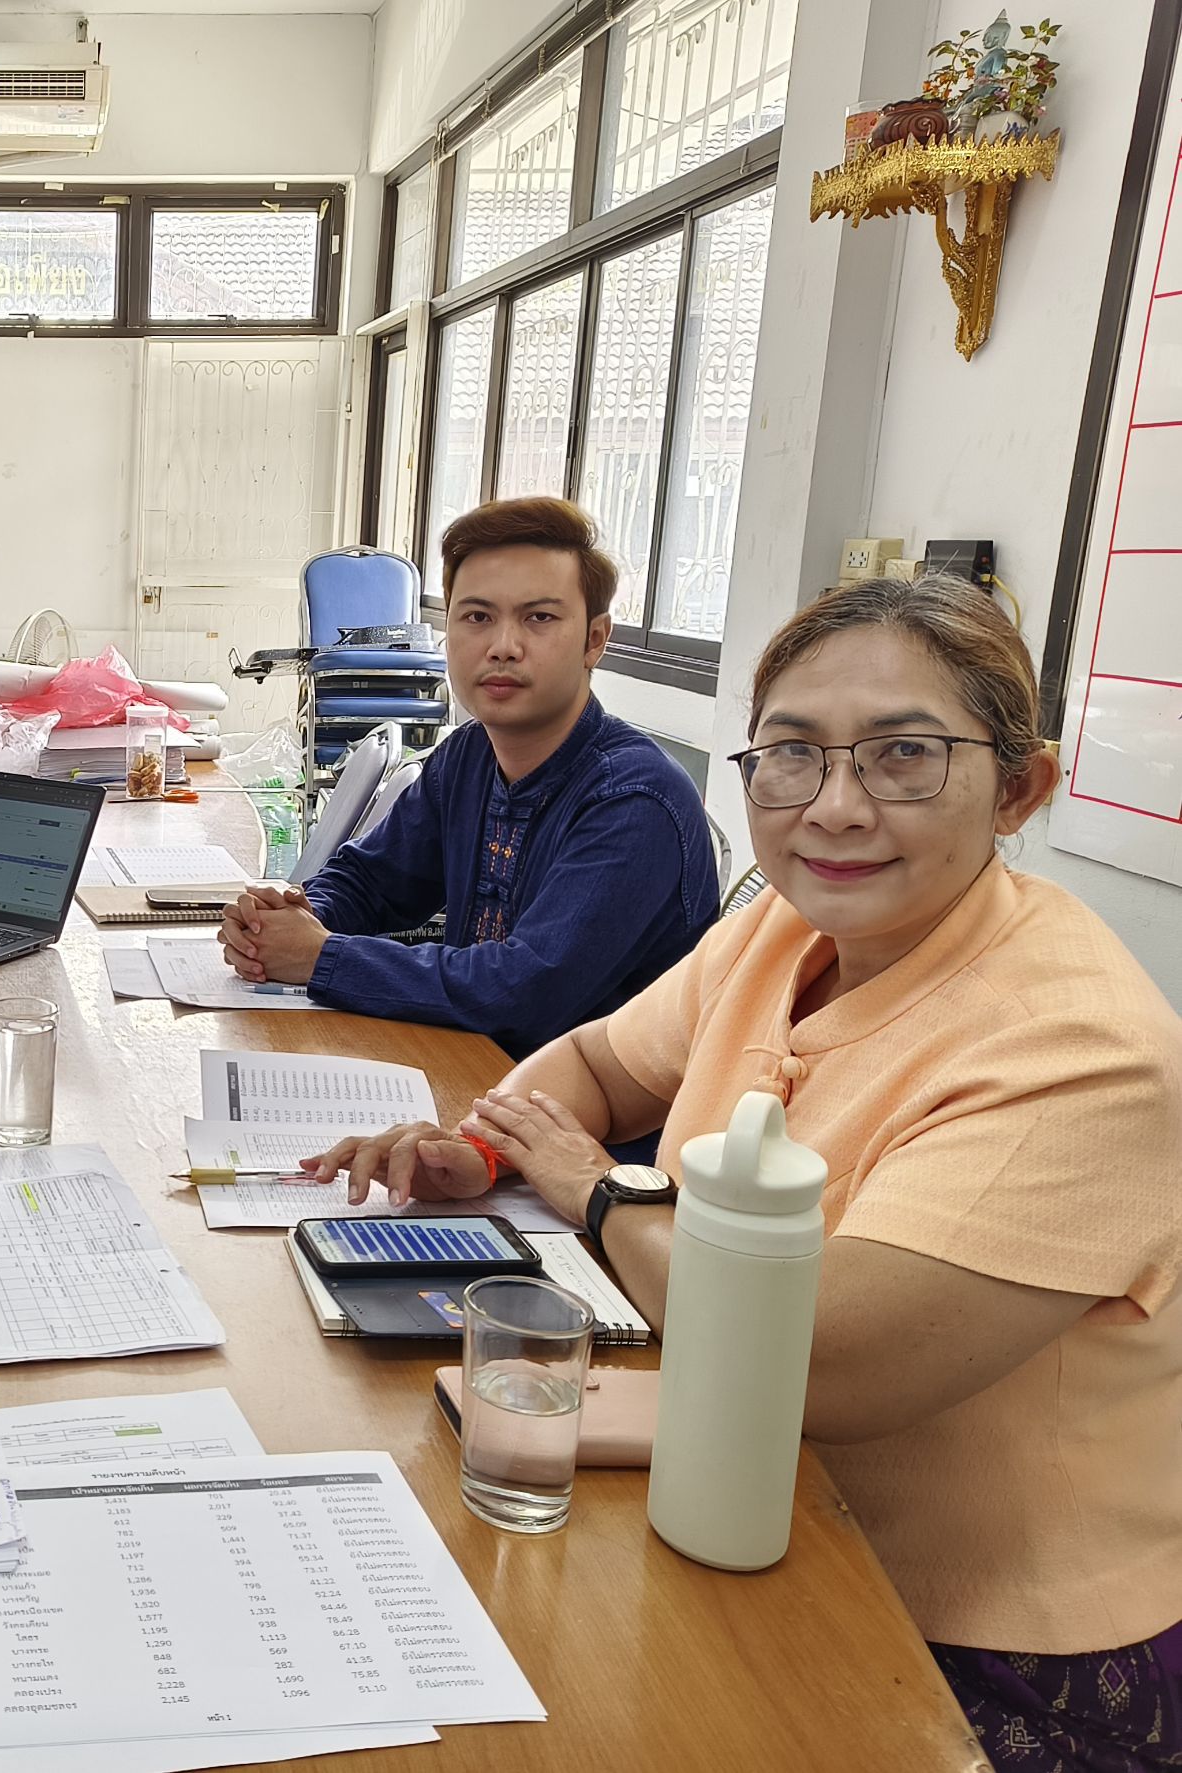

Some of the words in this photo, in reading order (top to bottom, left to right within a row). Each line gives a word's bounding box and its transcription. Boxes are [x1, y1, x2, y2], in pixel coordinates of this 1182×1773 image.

[91, 1468, 186, 1479] รายงานความคืบหน้า
[71, 1485, 154, 1495] เป้าหมายการจัดเก็บ
[184, 1480, 240, 1490] ผลการจัดเก็บ
[268, 1489, 292, 1497] 20.43
[316, 1485, 373, 1494] ยังไม่ตรวจสอบ
[208, 1503, 232, 1511] 2,017
[322, 1496, 378, 1504] ยังไม่ตรวจสอบ
[278, 1510, 302, 1518] 37.42
[327, 1506, 385, 1514] ยังไม่ตรวจสอบ
[332, 1517, 391, 1525] ยังไม่ตรวจสอบ
[116, 1541, 141, 1549] 2,019
[221, 1536, 246, 1544] 1,441
[288, 1532, 312, 1540] 71.37
[338, 1528, 398, 1536] ยังไม่ตรวจสอบ
[120, 1552, 144, 1560] 1,197
[344, 1539, 404, 1548] ยังไม่ตรวจสอบ
[127, 1564, 145, 1572] 712
[298, 1554, 324, 1562] 55.34
[350, 1550, 410, 1559] ยังไม่ตรวจสอบ
[127, 1576, 152, 1584] 1,286
[304, 1566, 328, 1574] 73.17
[356, 1562, 417, 1570] ยังไม่ตรวจสอบ
[130, 1588, 156, 1596] 1,936
[243, 1582, 262, 1590] 798
[310, 1578, 336, 1586] 41.22
[362, 1574, 424, 1582] ยังไม่ตรวจสอบ
[134, 1601, 160, 1609] 1,520
[314, 1590, 342, 1598] 52.24
[368, 1586, 431, 1595] ยังไม่ตรวจสอบ
[138, 1614, 163, 1622] 1,577
[250, 1608, 276, 1616] 1,332
[320, 1603, 348, 1611] 84.46
[374, 1598, 438, 1608] ยังไม่ตรวจสอบ
[142, 1627, 168, 1635] 1,195
[258, 1620, 277, 1628] 938
[326, 1616, 354, 1624] 78.49
[381, 1611, 445, 1620] ยังไม่ตรวจสอบ
[146, 1640, 172, 1648] 1,290
[260, 1634, 287, 1642] 1,113
[332, 1628, 360, 1637] 86.28
[388, 1624, 452, 1634] ยังไม่ตรวจสอบ
[268, 1648, 288, 1656] 569
[339, 1642, 366, 1650] 67.10
[394, 1638, 460, 1647] ยังไม่ตรวจสอบ
[158, 1667, 177, 1675] 682
[274, 1661, 294, 1670] 282
[346, 1656, 373, 1664] 41.35
[402, 1651, 468, 1660] ยังไม่ตรวจสอบ
[157, 1681, 186, 1690] 2,228
[276, 1675, 304, 1684] 1,690
[351, 1670, 380, 1679] 75.85
[408, 1665, 476, 1675] ยังไม่ตรวจสอบ
[162, 1696, 190, 1704] 2,145
[282, 1689, 310, 1698] 1,096
[358, 1684, 387, 1694] 51.10
[416, 1680, 484, 1690] ยังไม่ตรวจสอบ
[207, 1713, 224, 1722] หน้า
